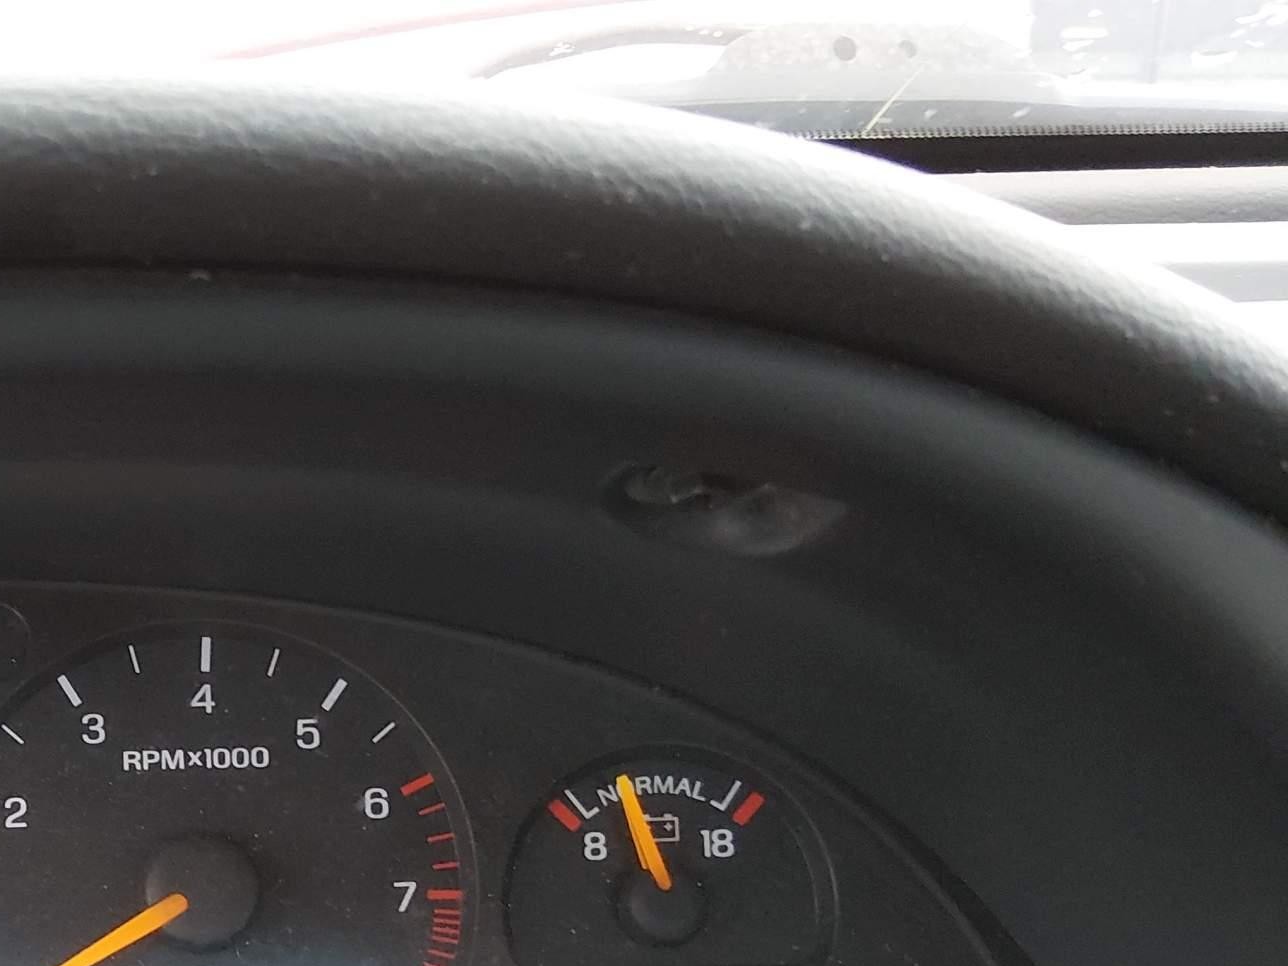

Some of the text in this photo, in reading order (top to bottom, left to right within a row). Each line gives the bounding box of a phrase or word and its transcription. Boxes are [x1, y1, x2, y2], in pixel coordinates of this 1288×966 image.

[191, 684, 215, 713] 4
[82, 714, 105, 744] 3
[297, 719, 319, 748] 5
[365, 788, 388, 818] 6
[597, 776, 705, 806] NRMAL
[5, 798, 27, 827] 2
[584, 832, 607, 860] 8
[701, 829, 734, 857] 18
[394, 882, 416, 912] 7
